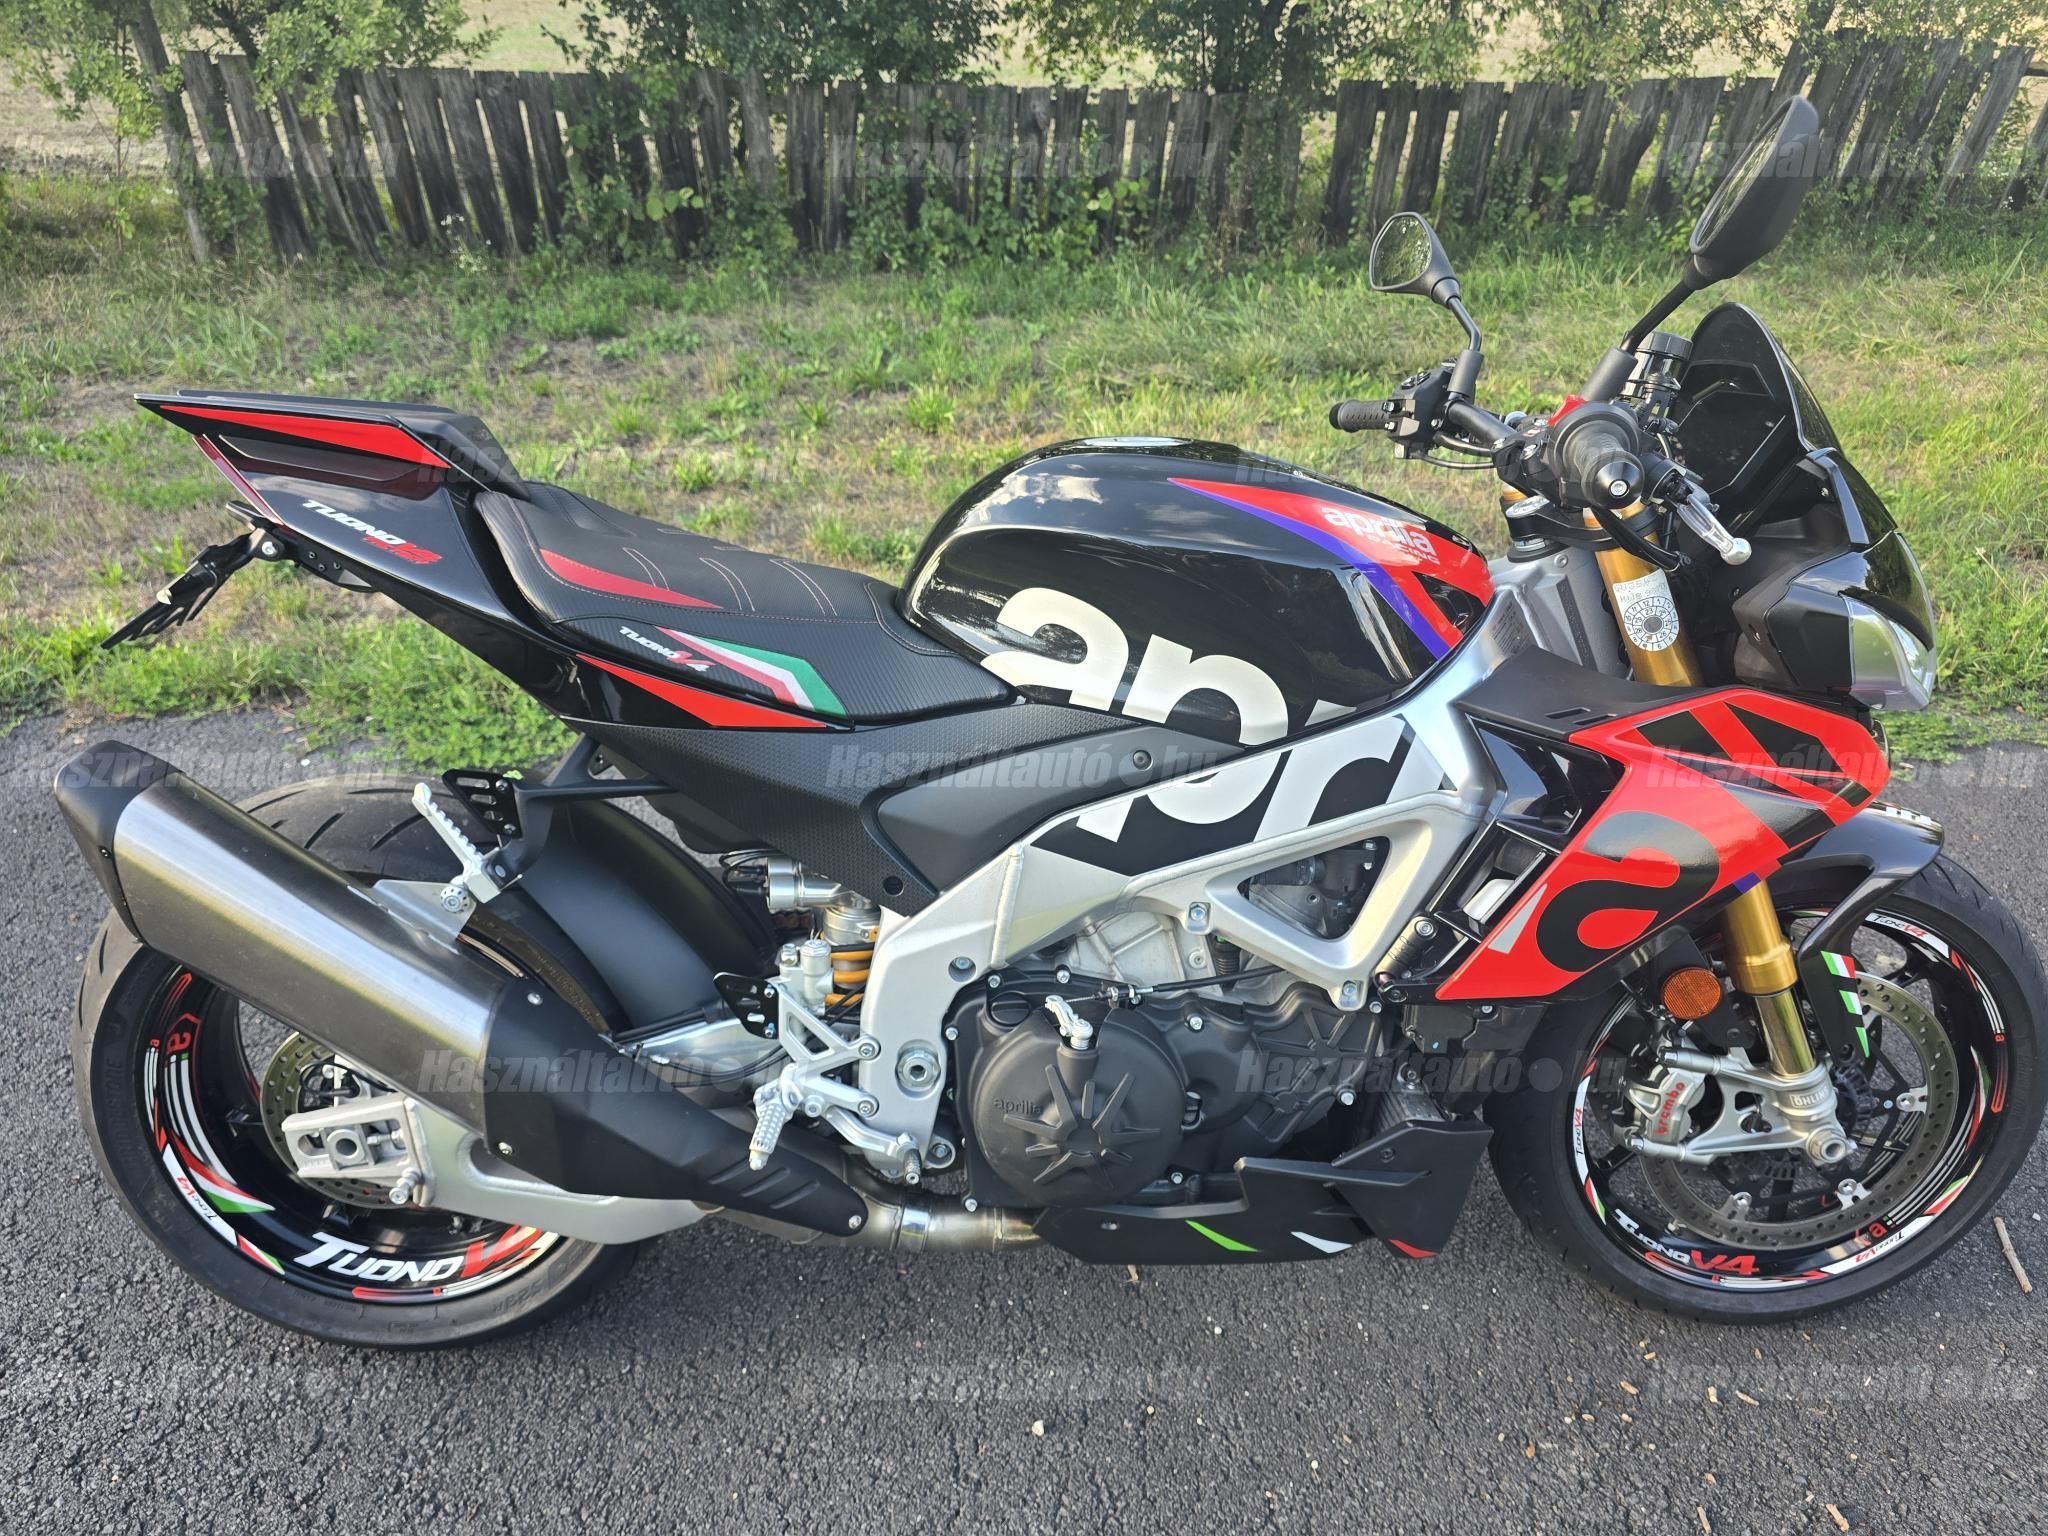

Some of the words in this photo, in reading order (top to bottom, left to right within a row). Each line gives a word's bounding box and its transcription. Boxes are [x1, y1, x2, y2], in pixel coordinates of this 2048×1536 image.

[302, 499, 407, 545] TUONO
[1321, 507, 1439, 557] aprilia
[619, 625, 681, 659] TUONO
[992, 1097, 1044, 1114] aprilia
[1655, 1082, 1686, 1136] brembo
[293, 1231, 465, 1283] TUONO
[1613, 1208, 1691, 1265] TUONO
[1690, 1249, 1760, 1276] V4
